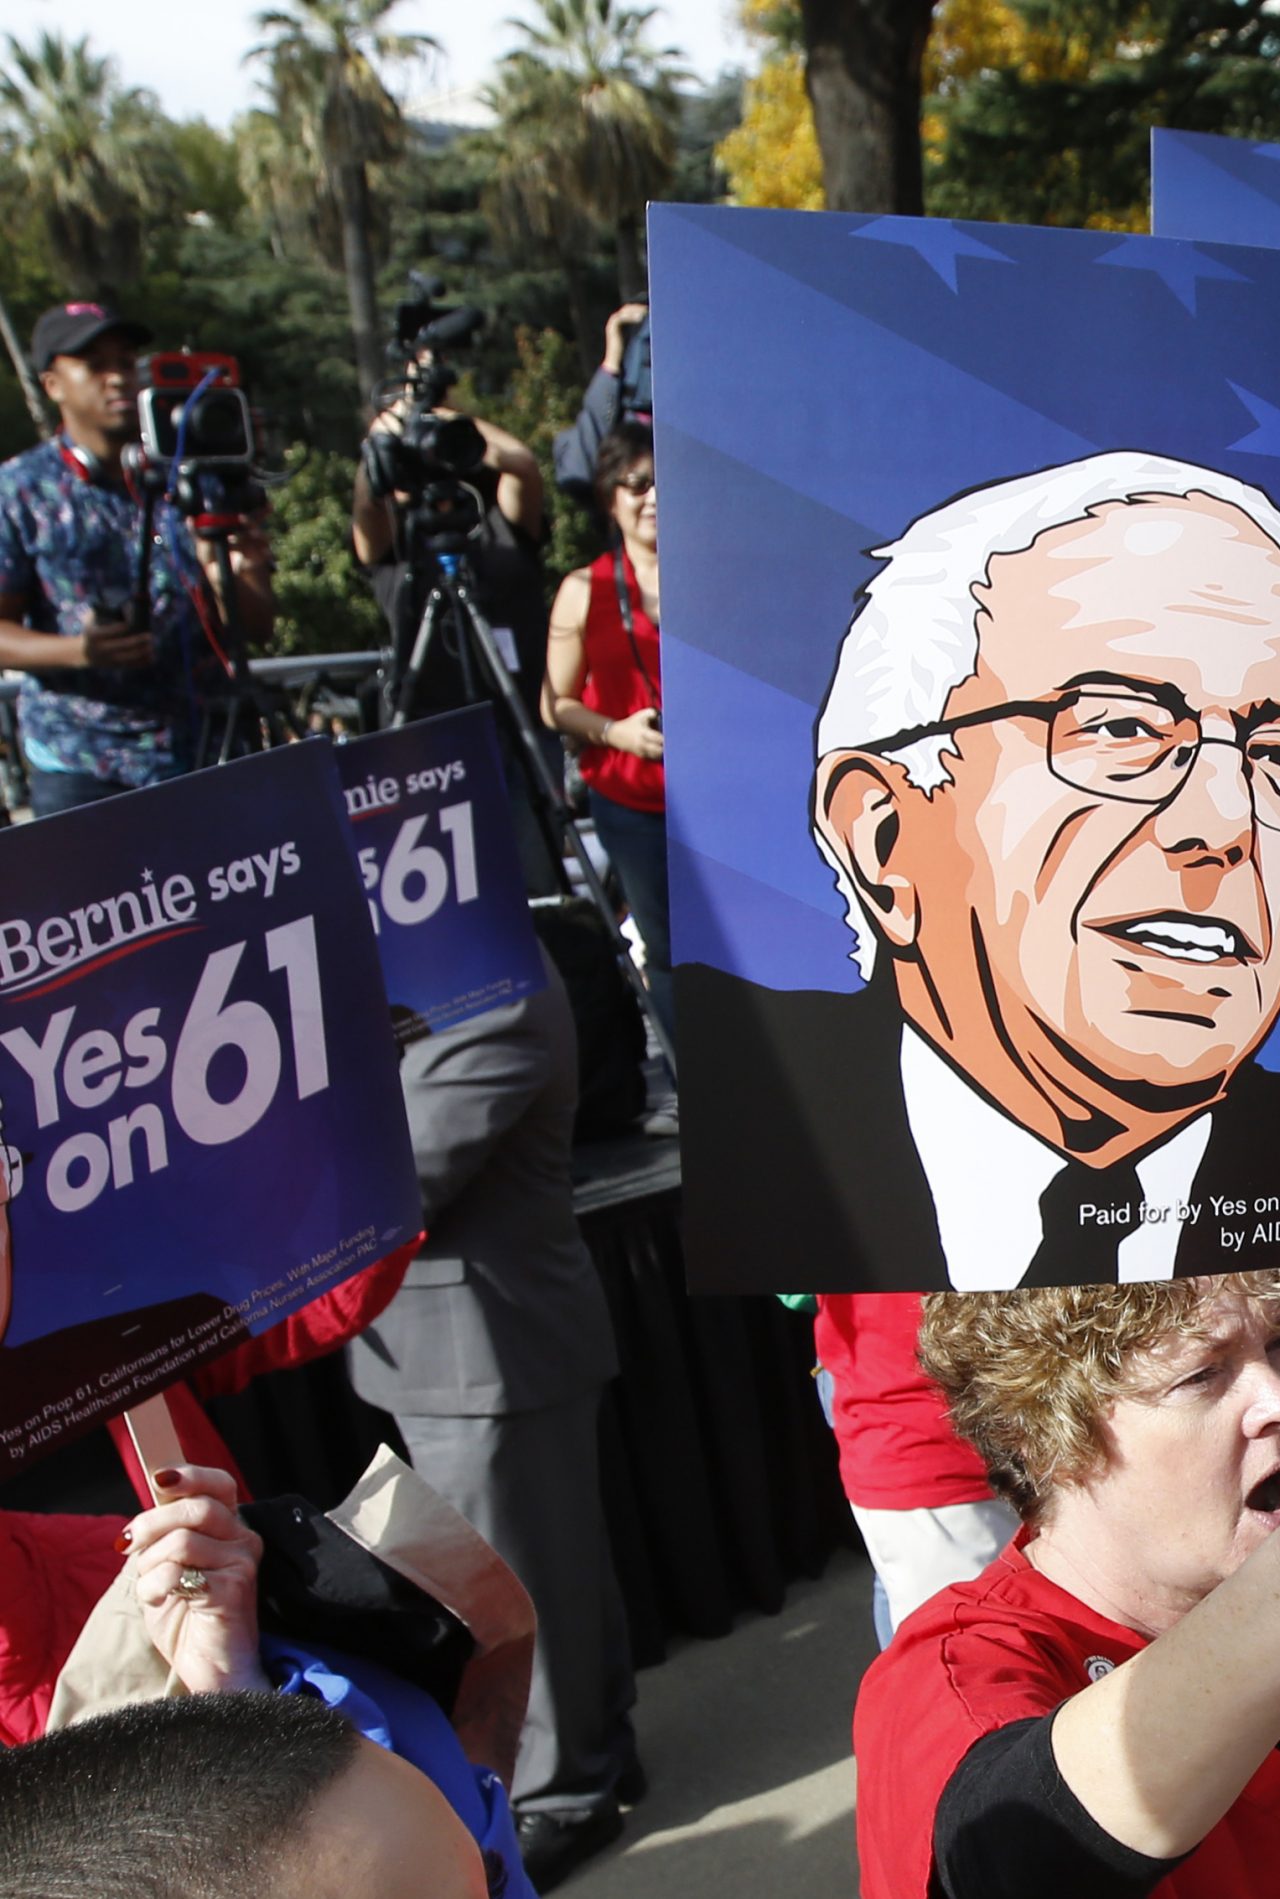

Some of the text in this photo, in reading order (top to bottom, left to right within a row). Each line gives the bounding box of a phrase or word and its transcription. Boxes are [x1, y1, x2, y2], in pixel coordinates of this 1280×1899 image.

[405, 760, 466, 794] says
[0, 867, 197, 985] Bernie
[208, 841, 301, 901] says
[380, 800, 479, 926] 61
[0, 1005, 167, 1129] Yes
[171, 914, 329, 1145] 61
[46, 1103, 168, 1213] on
[1079, 1202, 1130, 1226] Paid
[1138, 1201, 1170, 1222] for
[1176, 1199, 1201, 1225] by
[1209, 1195, 1247, 1217] Yes
[1254, 1195, 1279, 1213] on
[1220, 1227, 1245, 1252] by
[0, 1426, 22, 1444] Yes
[24, 1415, 41, 1431] on
[42, 1396, 74, 1419] Prop
[99, 1343, 169, 1388] Californians
[170, 1334, 186, 1349] for
[188, 1315, 221, 1340] Lower
[223, 1298, 250, 1319] Drug
[311, 1248, 338, 1270] Major
[339, 1225, 376, 1252] Funding
[9, 1444, 26, 1459] by
[28, 1419, 63, 1448] AIDS
[64, 1384, 131, 1426] Healthcare
[132, 1347, 196, 1389] Foundation
[199, 1333, 218, 1350] and
[219, 1306, 268, 1340] California
[269, 1286, 304, 1311] Nurses
